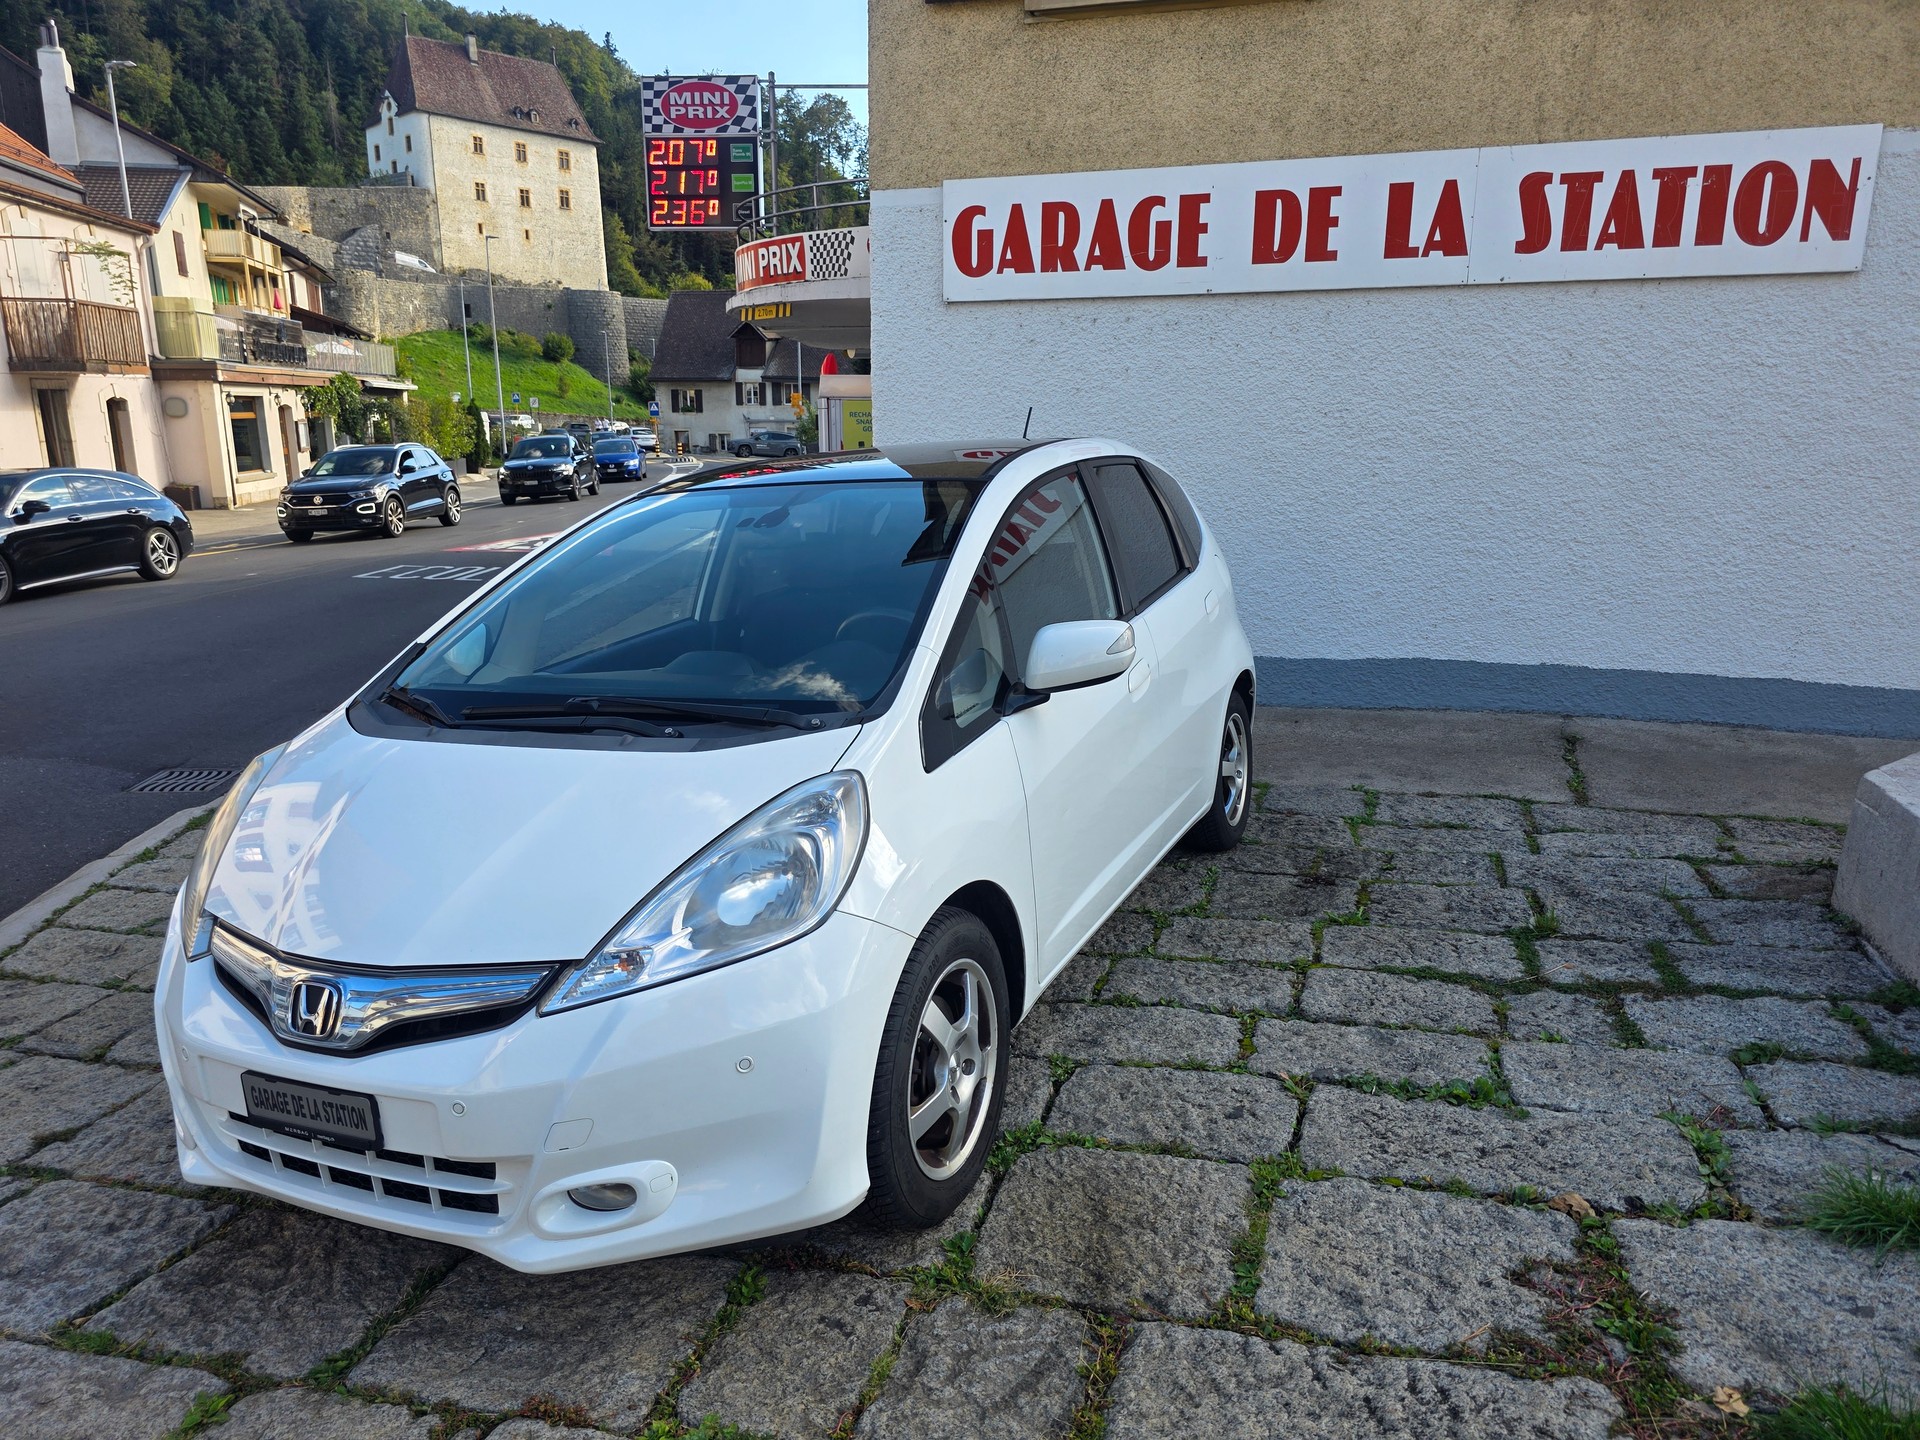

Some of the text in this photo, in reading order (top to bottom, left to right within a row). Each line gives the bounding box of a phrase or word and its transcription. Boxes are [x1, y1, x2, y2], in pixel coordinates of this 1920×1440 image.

[669, 91, 730, 105] MINI
[670, 106, 731, 119] PRIX
[952, 156, 1862, 278] GARAGE DE LA STATION
[737, 241, 803, 285] MINI PRIX
[903, 975, 928, 1044] SUPERGRIP
[250, 1086, 367, 1130] GARAGE DE LA STATION
